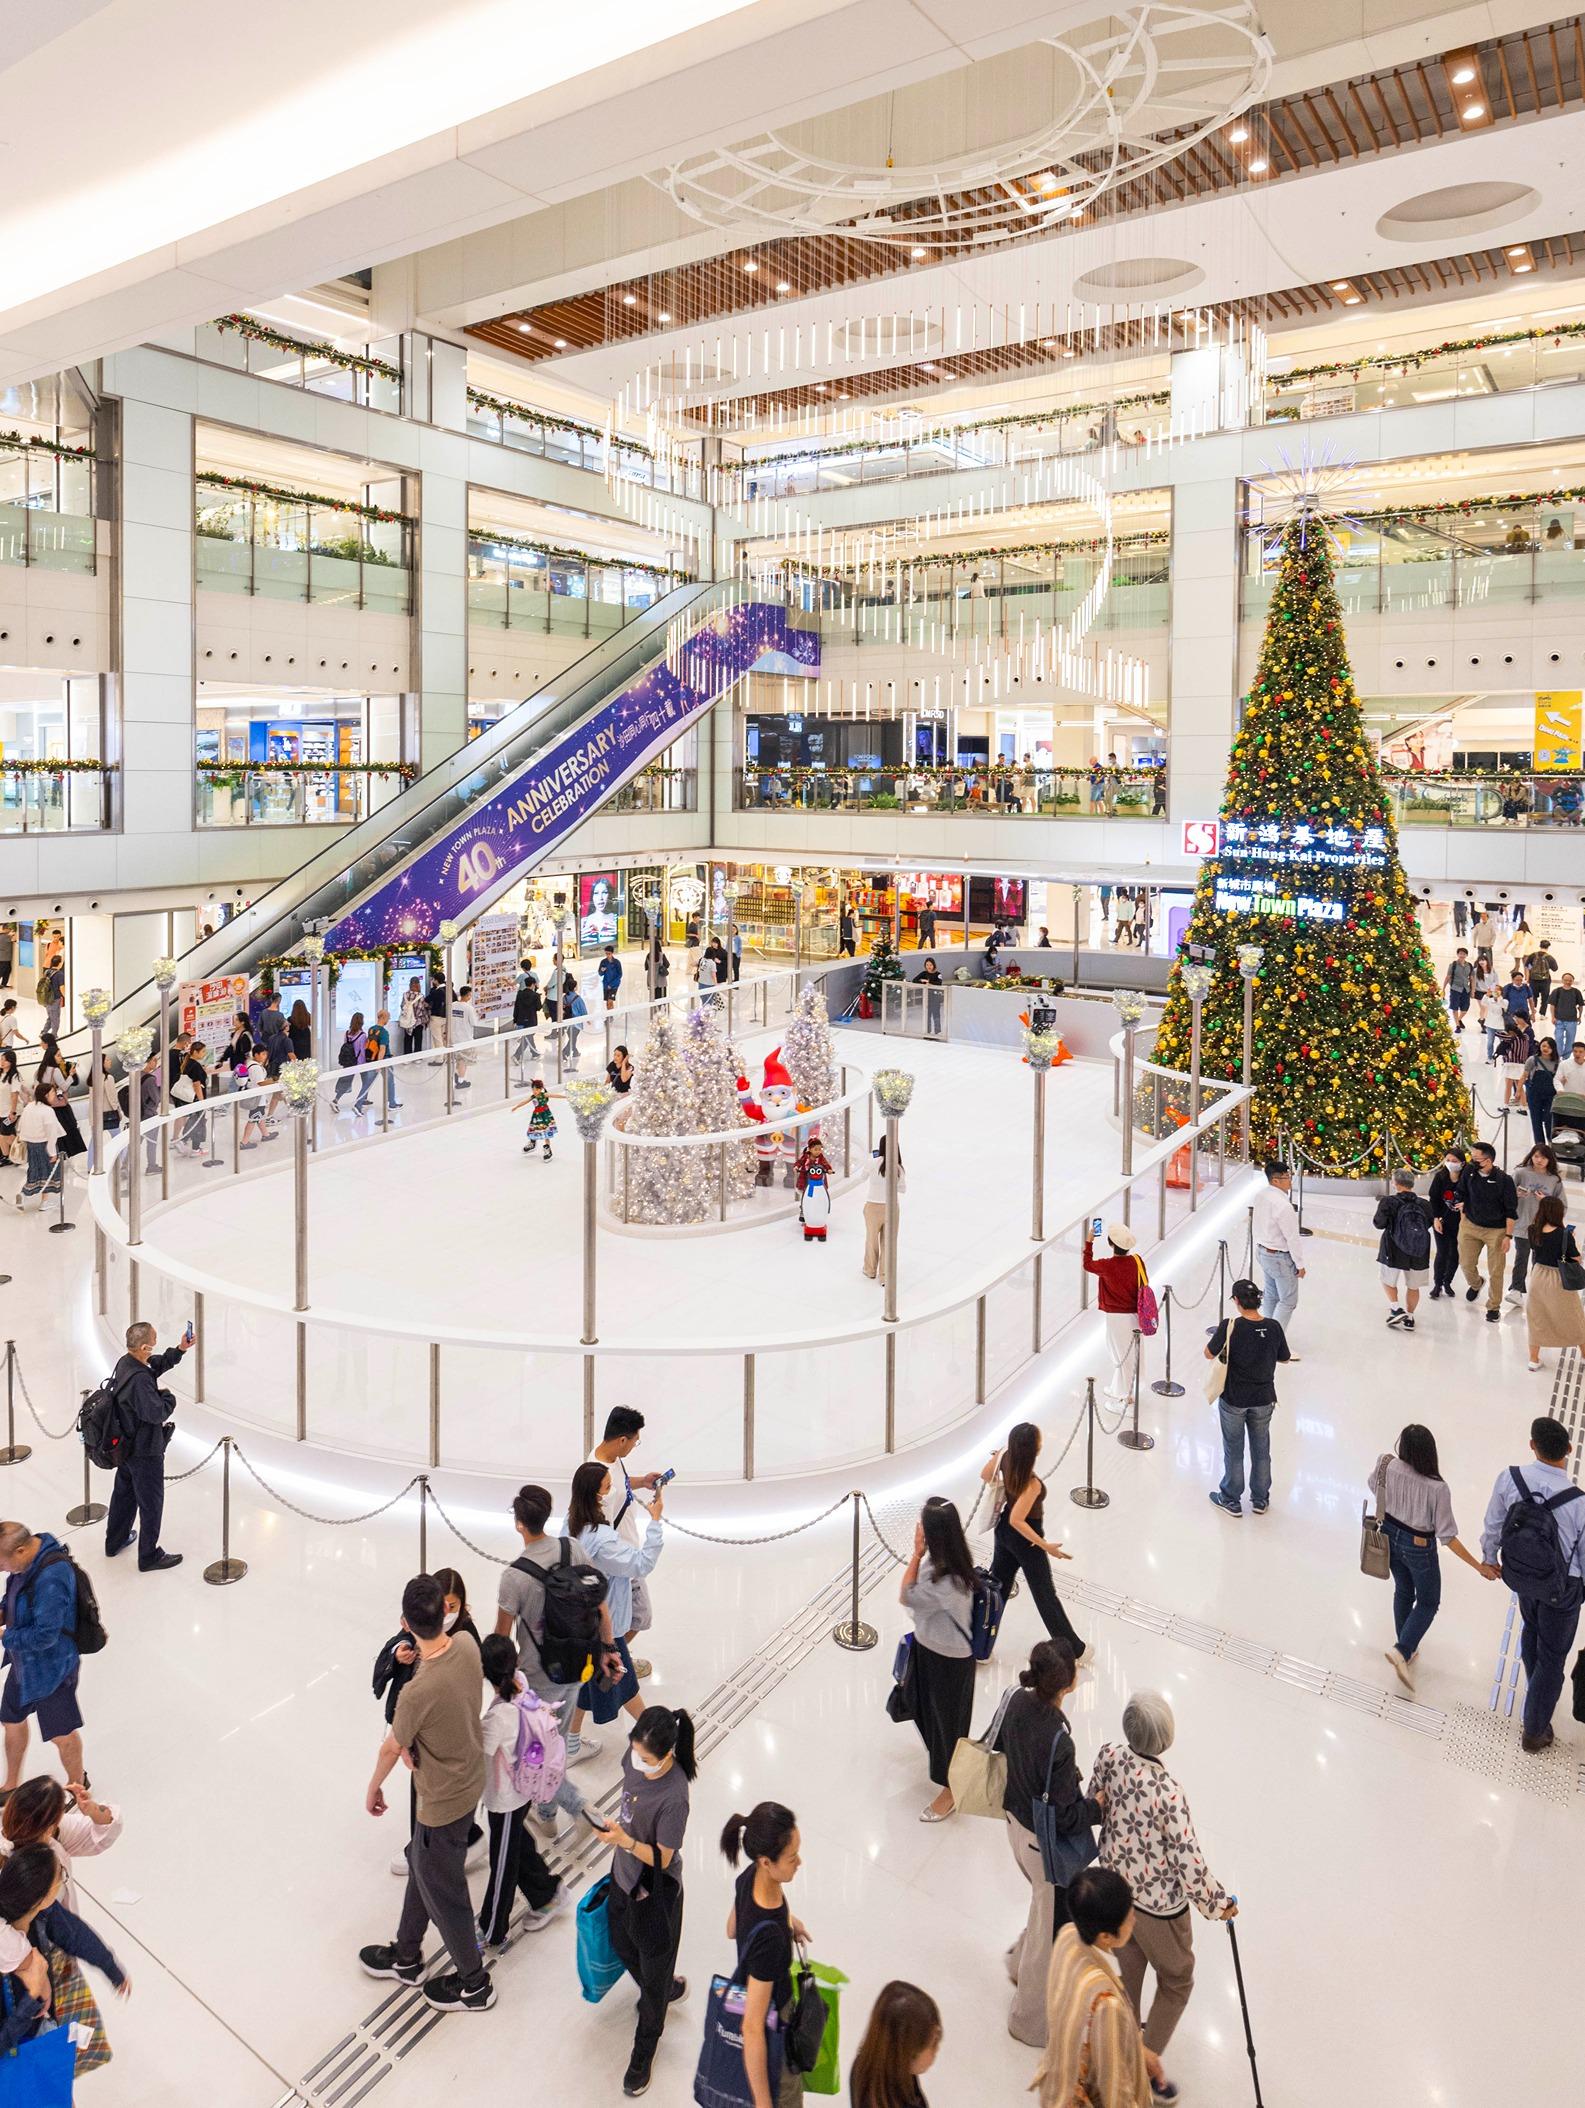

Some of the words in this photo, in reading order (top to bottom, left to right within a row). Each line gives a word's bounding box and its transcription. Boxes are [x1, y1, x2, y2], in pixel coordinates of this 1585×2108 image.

[506, 723, 617, 833] ANNIVERSARY
[531, 759, 610, 833] CELEBRATION
[441, 853, 454, 875] NEW
[451, 831, 473, 853] TOWN
[473, 826, 496, 837] PLAZA
[1223, 845, 1248, 858] Sun
[1251, 847, 1286, 862] Hung
[1289, 849, 1312, 862] Kai
[1315, 850, 1385, 866] Properties
[1215, 890, 1252, 911] New
[1253, 894, 1297, 915] Town
[1297, 897, 1343, 919] Plaza
